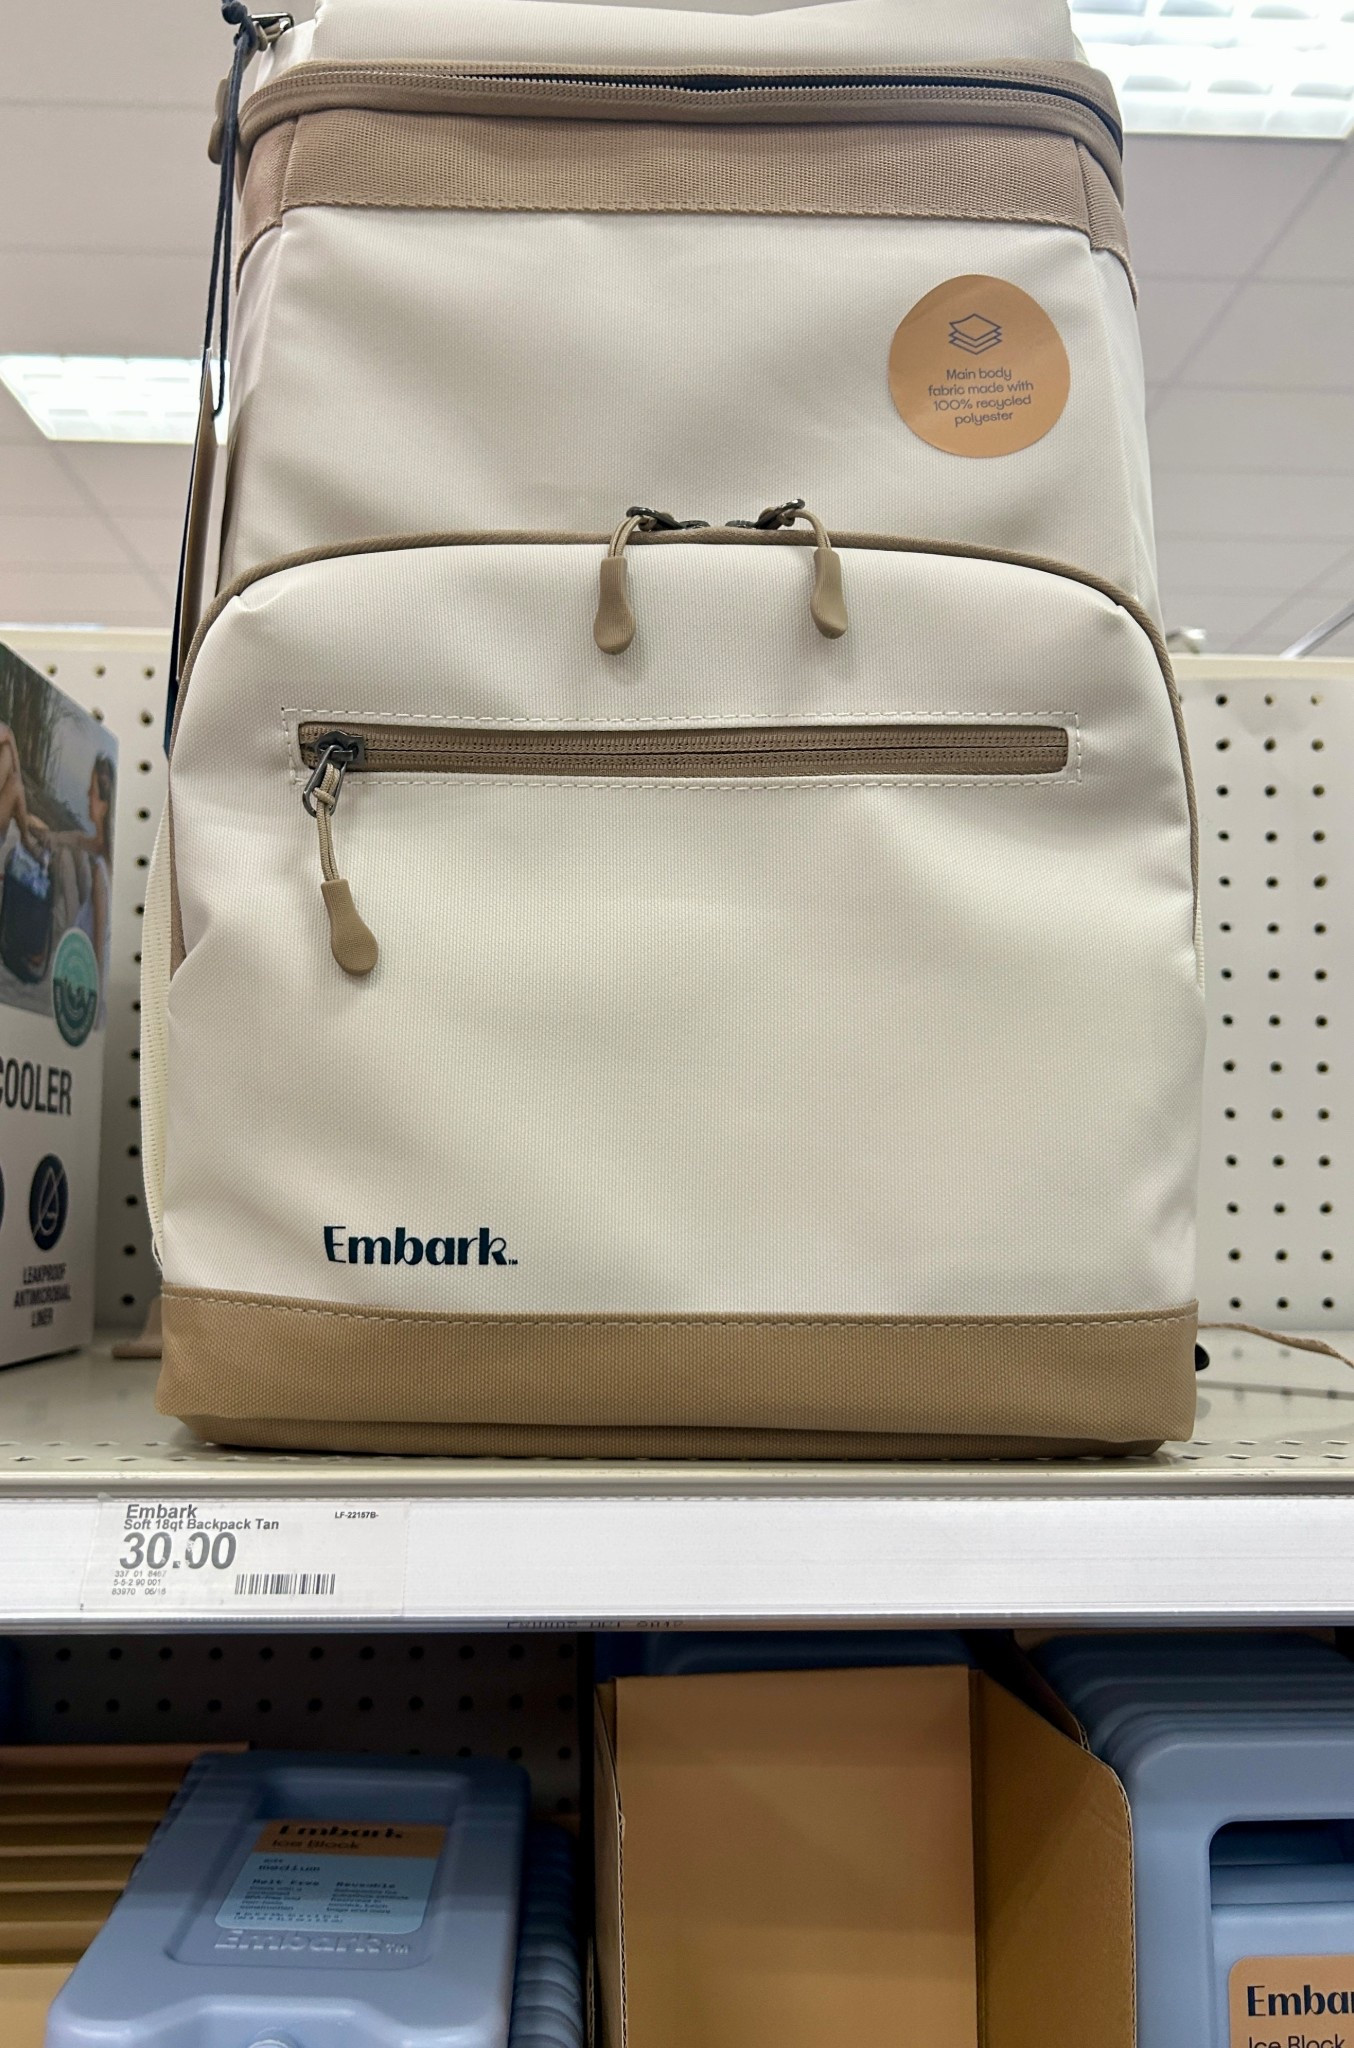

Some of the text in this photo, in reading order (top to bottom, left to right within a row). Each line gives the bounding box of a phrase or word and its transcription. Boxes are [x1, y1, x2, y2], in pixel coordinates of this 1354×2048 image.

[946, 366, 1012, 381] Main body
[928, 380, 1034, 397] fabric made with
[934, 394, 1032, 411] 100% recycled
[954, 412, 1014, 428] polyester
[0, 1055, 72, 1116] OOLER
[126, 1503, 198, 1519] Embark
[123, 1518, 280, 1532] Soft 18qt Backpack Tan
[119, 1531, 237, 1570] 30.00
[114, 1570, 130, 1578] 337
[133, 1570, 143, 1578] 01
[147, 1578, 161, 1586] 001
[111, 1587, 136, 1595] 83970
[1247, 1984, 1354, 2016] Emba
